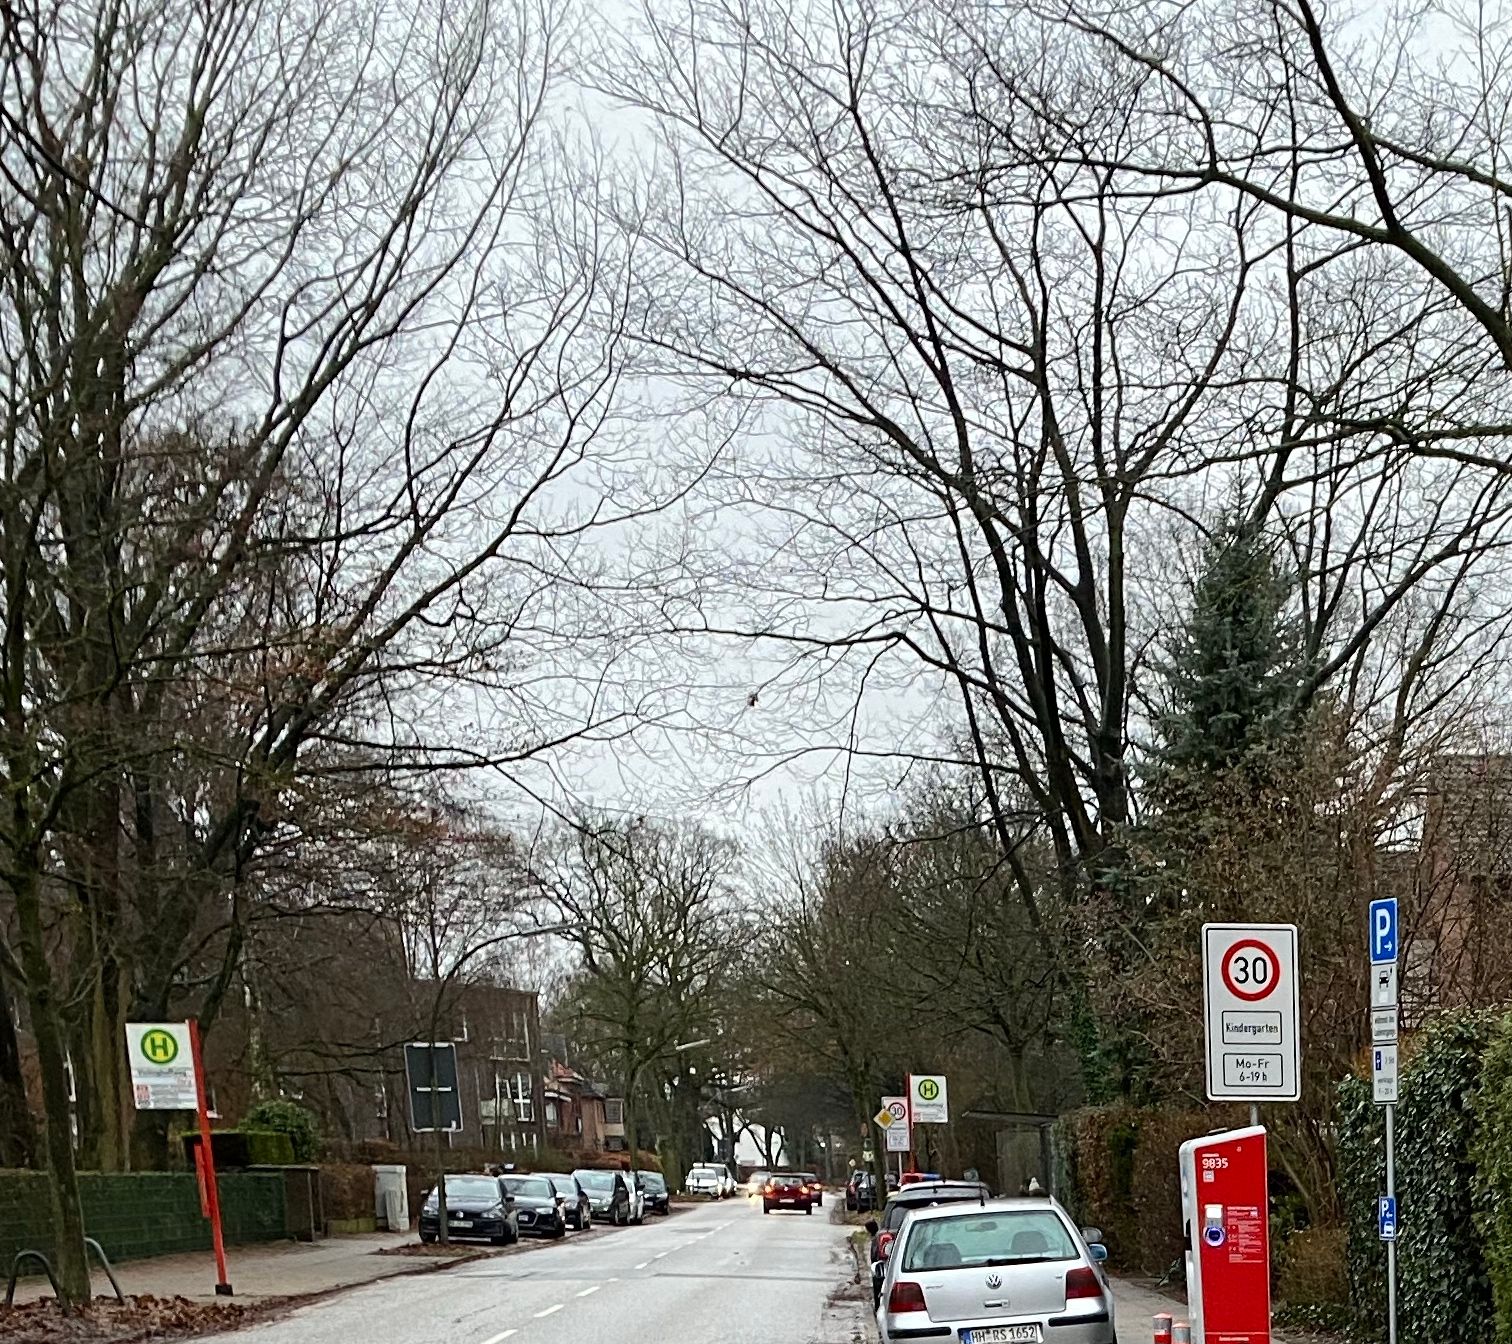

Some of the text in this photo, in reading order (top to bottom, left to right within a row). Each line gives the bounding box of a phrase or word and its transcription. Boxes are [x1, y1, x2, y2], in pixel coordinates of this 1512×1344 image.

[1375, 908, 1391, 955] P
[1233, 956, 1268, 985] 30
[1225, 1022, 1279, 1036] Kindergarten
[150, 1036, 169, 1057] H
[1235, 1058, 1270, 1069] Mo-Fr
[1239, 1071, 1260, 1082] 6-19
[923, 1083, 934, 1096] H
[1202, 1157, 1229, 1169] 9835
[993, 1328, 1007, 1341] RS
[1010, 1326, 1036, 1340] 1652
